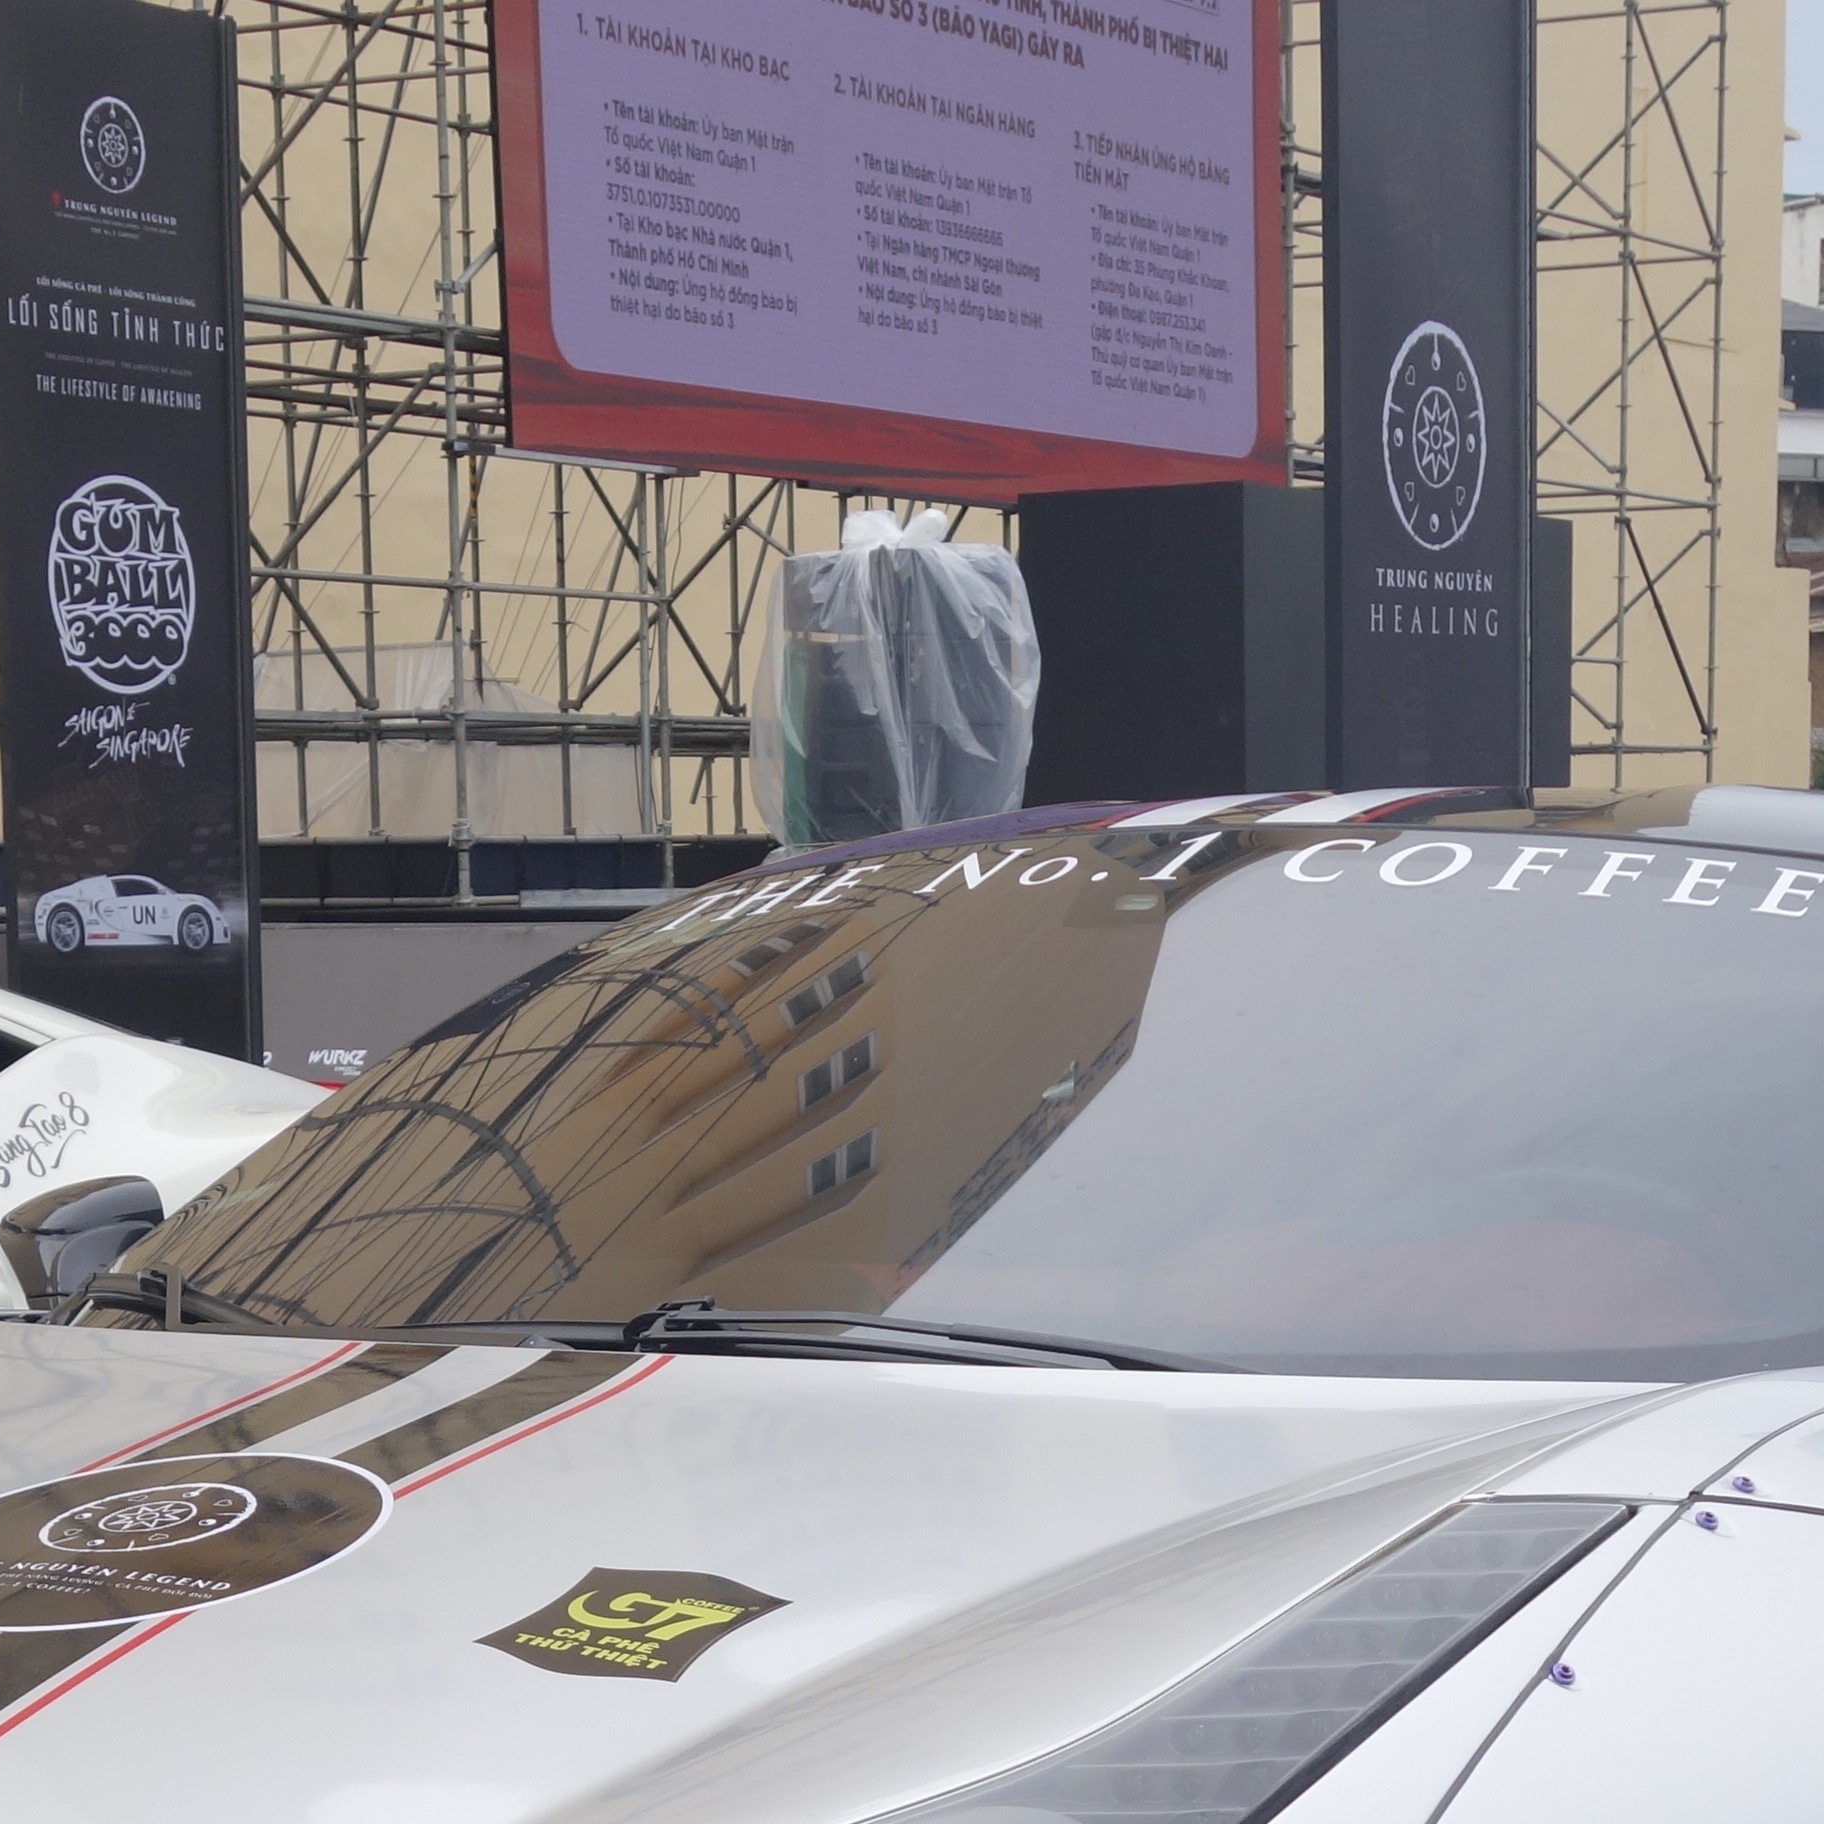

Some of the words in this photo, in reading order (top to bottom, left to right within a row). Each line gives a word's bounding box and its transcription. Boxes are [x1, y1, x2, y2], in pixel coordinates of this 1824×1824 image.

[576, 12, 588, 36] 1.
[595, 14, 622, 44] TÀI
[627, 24, 686, 58] KHOẢN
[690, 39, 716, 67] TẠI
[721, 48, 754, 73] KHO
[759, 54, 791, 82] BẠC
[917, 7, 928, 27] 3
[979, 18, 1024, 55] YAGI)
[1063, 41, 1085, 69] RA
[1108, 18, 1139, 44] PHỐ
[612, 99, 635, 121] Tên
[638, 103, 654, 125] tài
[722, 122, 743, 144] ban
[833, 73, 846, 95] 2.
[849, 75, 873, 101] TÀI
[876, 82, 927, 114] KHOẢN
[998, 112, 1036, 138] HÀNG
[634, 159, 651, 179] tài
[686, 142, 713, 163] Nam
[750, 156, 757, 173] 1
[616, 212, 635, 233] Tại
[638, 216, 663, 237] Kho
[666, 220, 688, 242] bạc
[750, 237, 782, 260] Quận
[608, 238, 647, 262] Thành
[650, 246, 675, 267] phố
[721, 260, 749, 279] Minh
[8, 293, 39, 328] LỐI
[49, 299, 98, 336] SỐNG
[172, 317, 226, 352] THỨC
[36, 373, 57, 395] THE
[60, 375, 118, 402] LIFESTYLE
[122, 382, 137, 403] OF
[140, 384, 202, 412] AWAKENING
[55, 493, 180, 556] GUM
[55, 555, 189, 611] BALL
[1375, 567, 1428, 590] TRUNG
[1433, 568, 1494, 593] NGUYÊN
[1369, 603, 1499, 638] HEALING
[88, 723, 194, 768] SINGAPORE
[654, 863, 887, 934] THE
[913, 838, 1221, 896] No.1
[132, 905, 157, 925] UN
[308, 1049, 368, 1066] WURKZ
[9, 1561, 119, 1578] NGUYÊN
[123, 1570, 232, 1592] LEGEND
[567, 1588, 739, 1641] G7
[681, 1597, 746, 1615] COFFEE
[551, 1625, 592, 1641] CÀ
[597, 1634, 661, 1655] PHÊ
[581, 1645, 669, 1669] THIỆT
